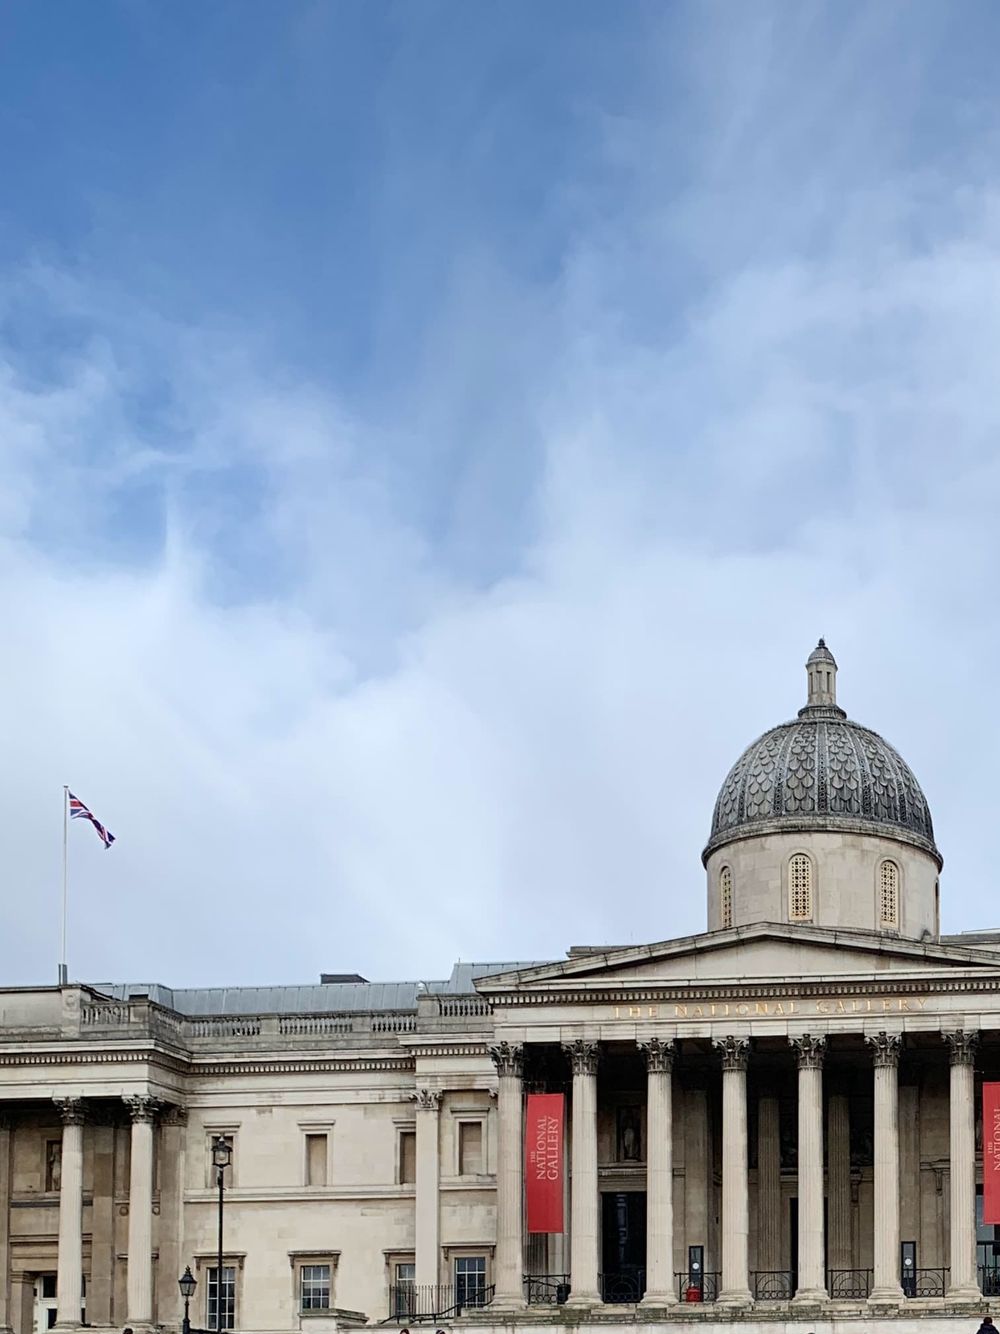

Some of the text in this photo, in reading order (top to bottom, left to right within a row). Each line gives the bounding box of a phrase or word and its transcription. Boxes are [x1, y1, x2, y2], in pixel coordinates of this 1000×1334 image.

[613, 998, 928, 1019] THE NATIONAL GALLERY
[536, 1115, 547, 1180] NATIONAL
[547, 1116, 559, 1181] GALLERY
